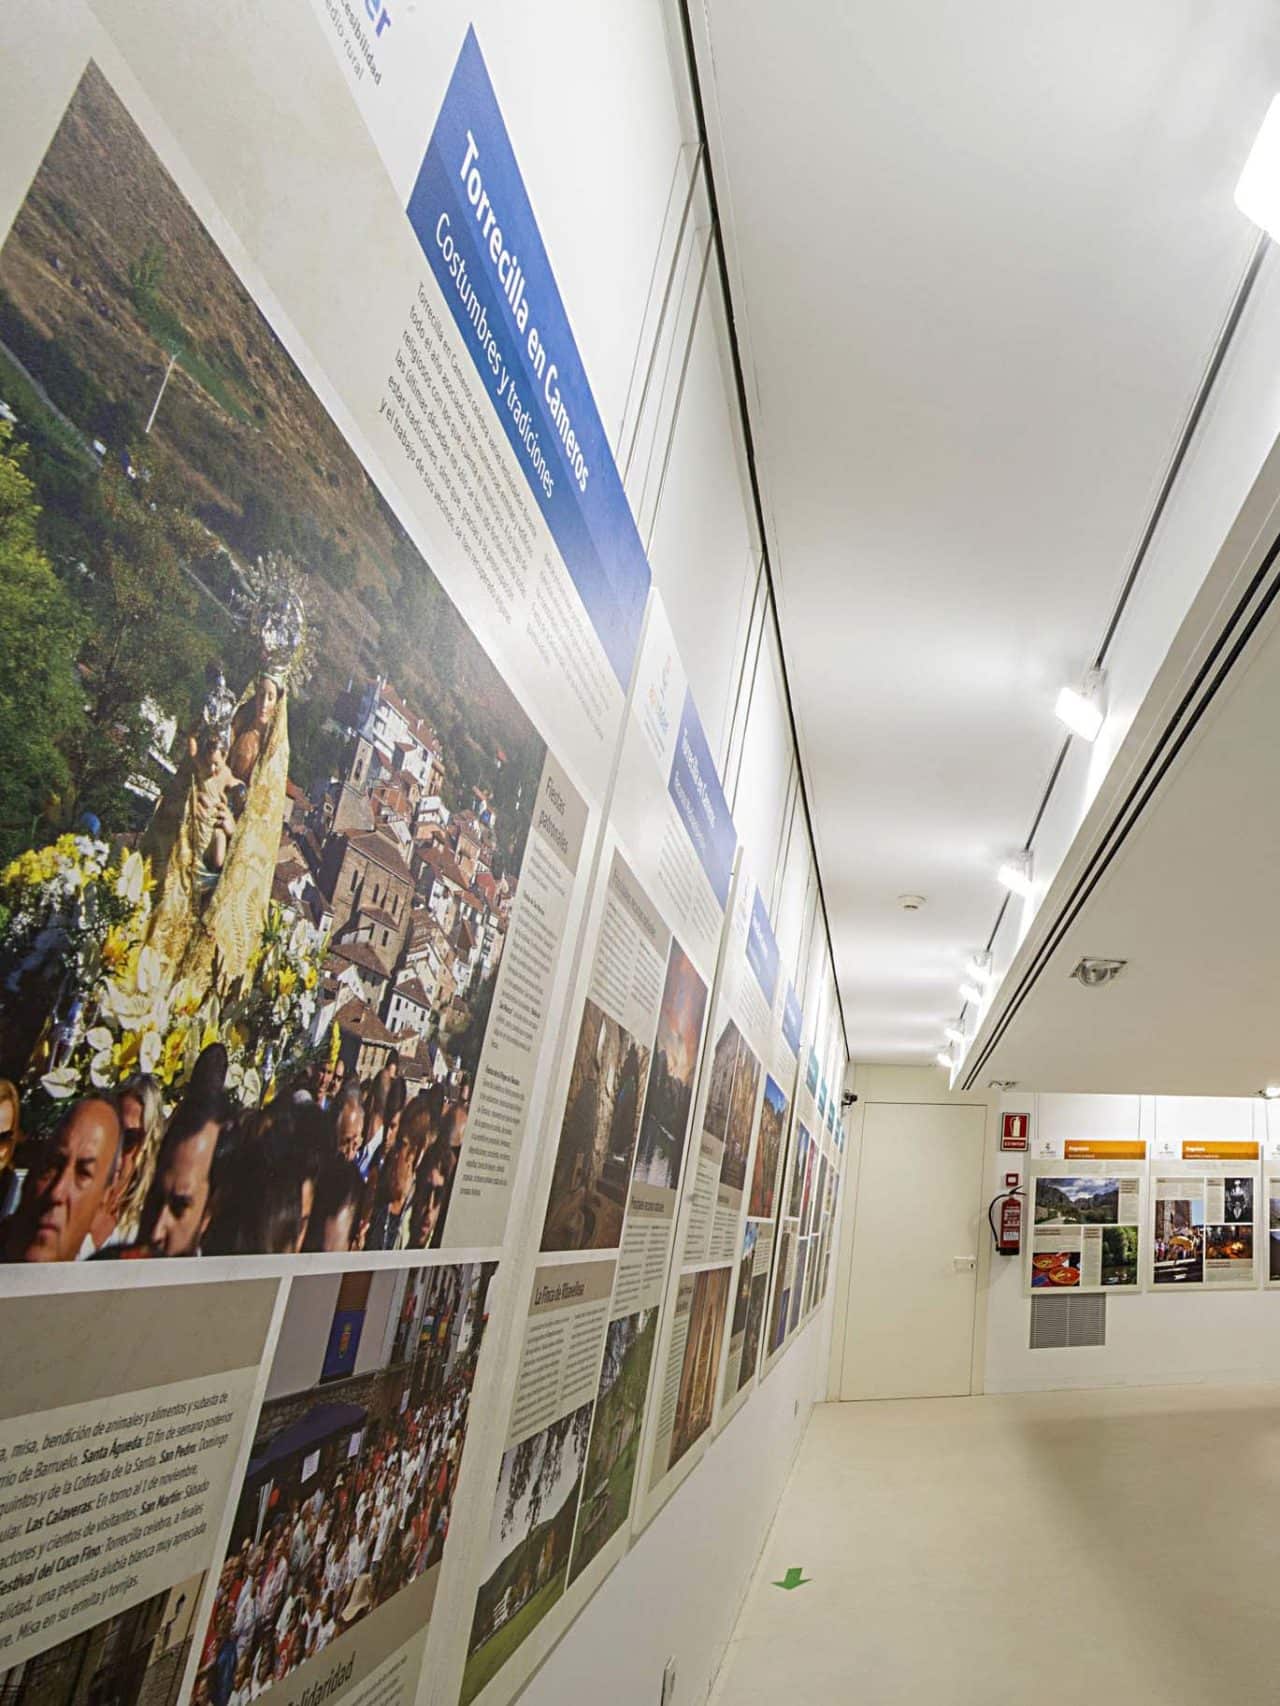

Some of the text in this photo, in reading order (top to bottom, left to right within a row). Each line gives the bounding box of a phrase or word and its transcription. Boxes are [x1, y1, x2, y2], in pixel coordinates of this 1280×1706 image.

[344, 39, 364, 80] rural
[409, 305, 424, 338] todo
[417, 283, 443, 341] Torrecilla
[442, 340, 451, 358] en
[460, 129, 588, 492] Torrecilla en Cameros
[395, 349, 405, 373] las
[436, 212, 554, 498] Costumbres y tradiciones
[388, 375, 405, 408] estas
[386, 408, 395, 423] el
[393, 417, 415, 460] trabajo
[415, 457, 424, 475] de
[11, 1440, 38, 1456] misa,
[42, 1425, 91, 1449] bendición
[92, 1422, 105, 1436] de
[105, 1414, 143, 1433] animales
[149, 1403, 186, 1421] alimentos
[17, 1466, 32, 1482] de
[81, 1447, 108, 1464] Santa
[47, 1484, 61, 1500] de
[62, 1480, 72, 1495] la
[111, 1464, 123, 1479] de
[124, 1461, 132, 1474] la
[24, 1517, 44, 1533] Las
[95, 1492, 108, 1509] En
[82, 1521, 95, 1537] de
[0, 1567, 37, 1595] estival
[37, 1560, 55, 1580] del
[55, 1554, 79, 1572] Cuco
